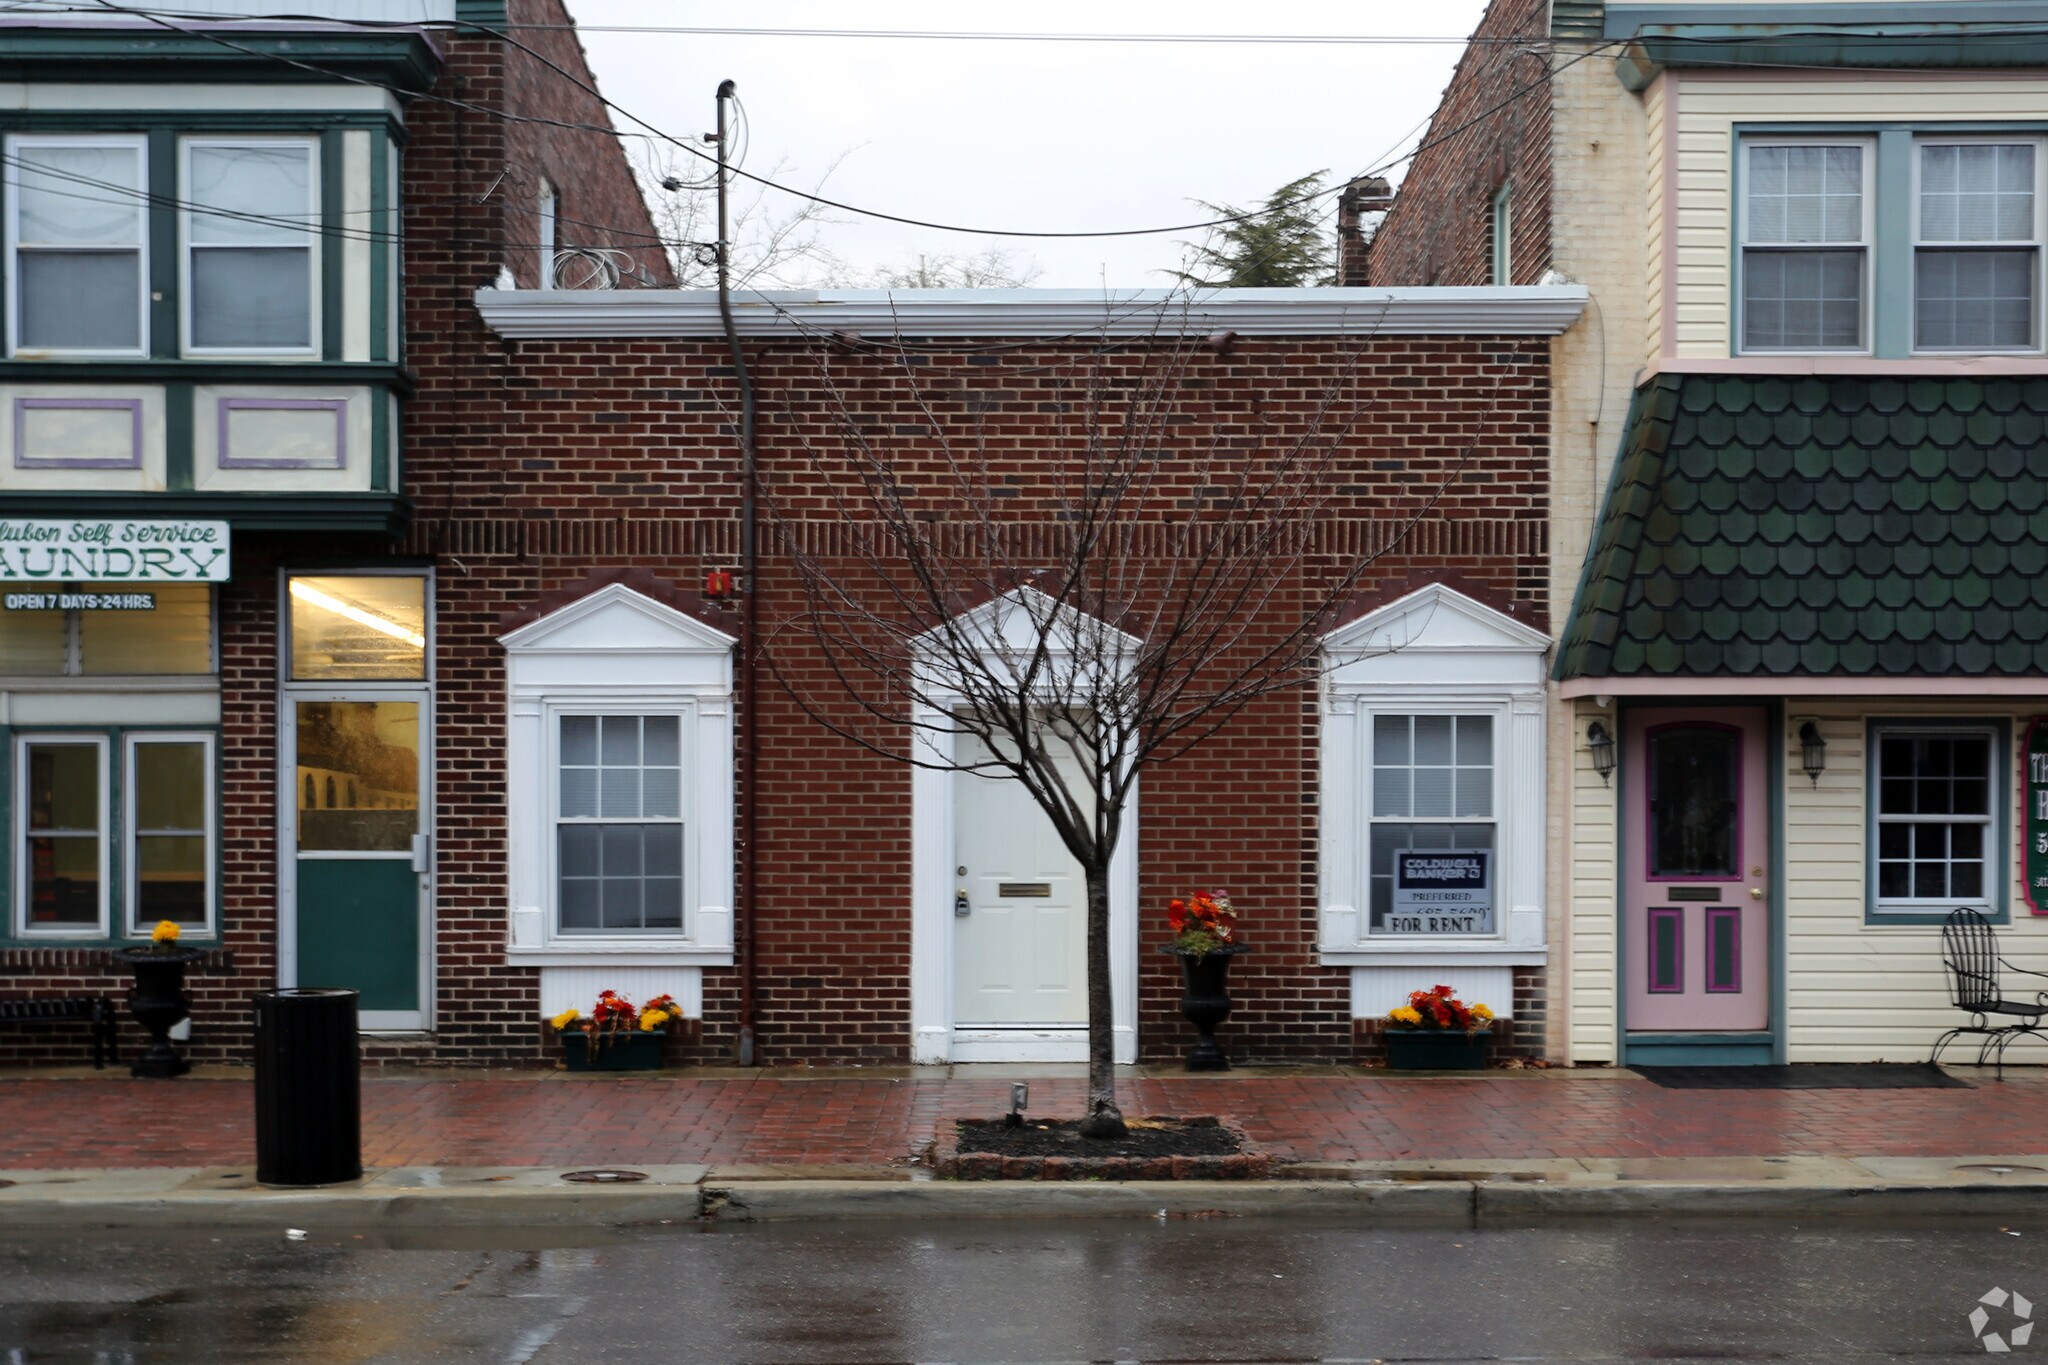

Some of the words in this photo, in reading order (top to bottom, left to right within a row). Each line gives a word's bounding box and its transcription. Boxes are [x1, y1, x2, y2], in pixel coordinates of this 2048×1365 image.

[68, 520, 114, 546] Self
[121, 522, 218, 543] Service
[6, 593, 45, 609] OPEN
[46, 594, 58, 609] 7
[1412, 892, 1472, 901] PREFERRED
[1390, 917, 1422, 932] FOR
[1428, 917, 1475, 932] RENT
